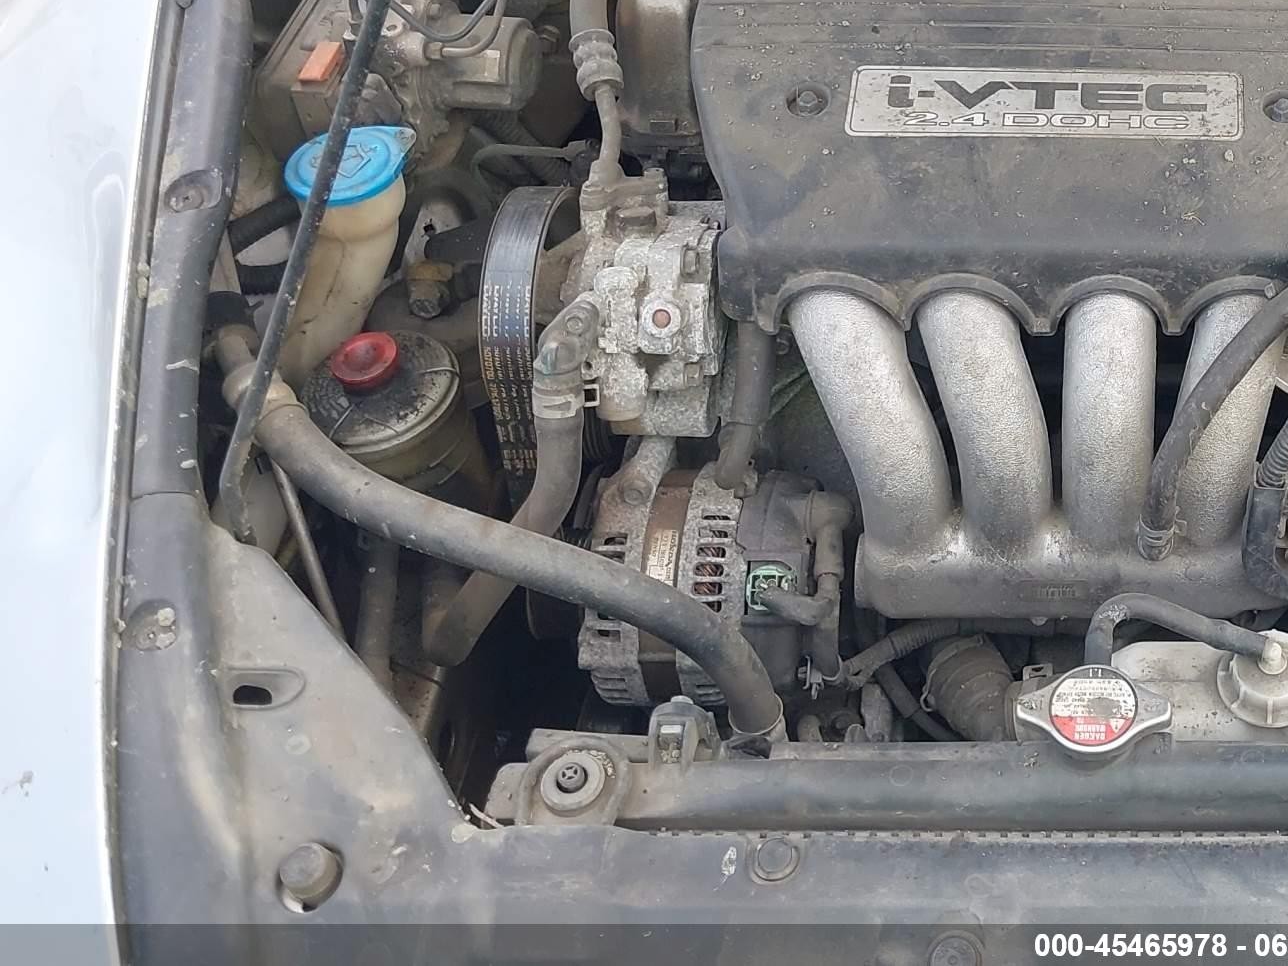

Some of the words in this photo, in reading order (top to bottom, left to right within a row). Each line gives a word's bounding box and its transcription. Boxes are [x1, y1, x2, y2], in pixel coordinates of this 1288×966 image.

[888, 75, 1208, 112] i-VTEC
[904, 111, 990, 127] 2.4
[1002, 113, 1190, 130] DOHC
